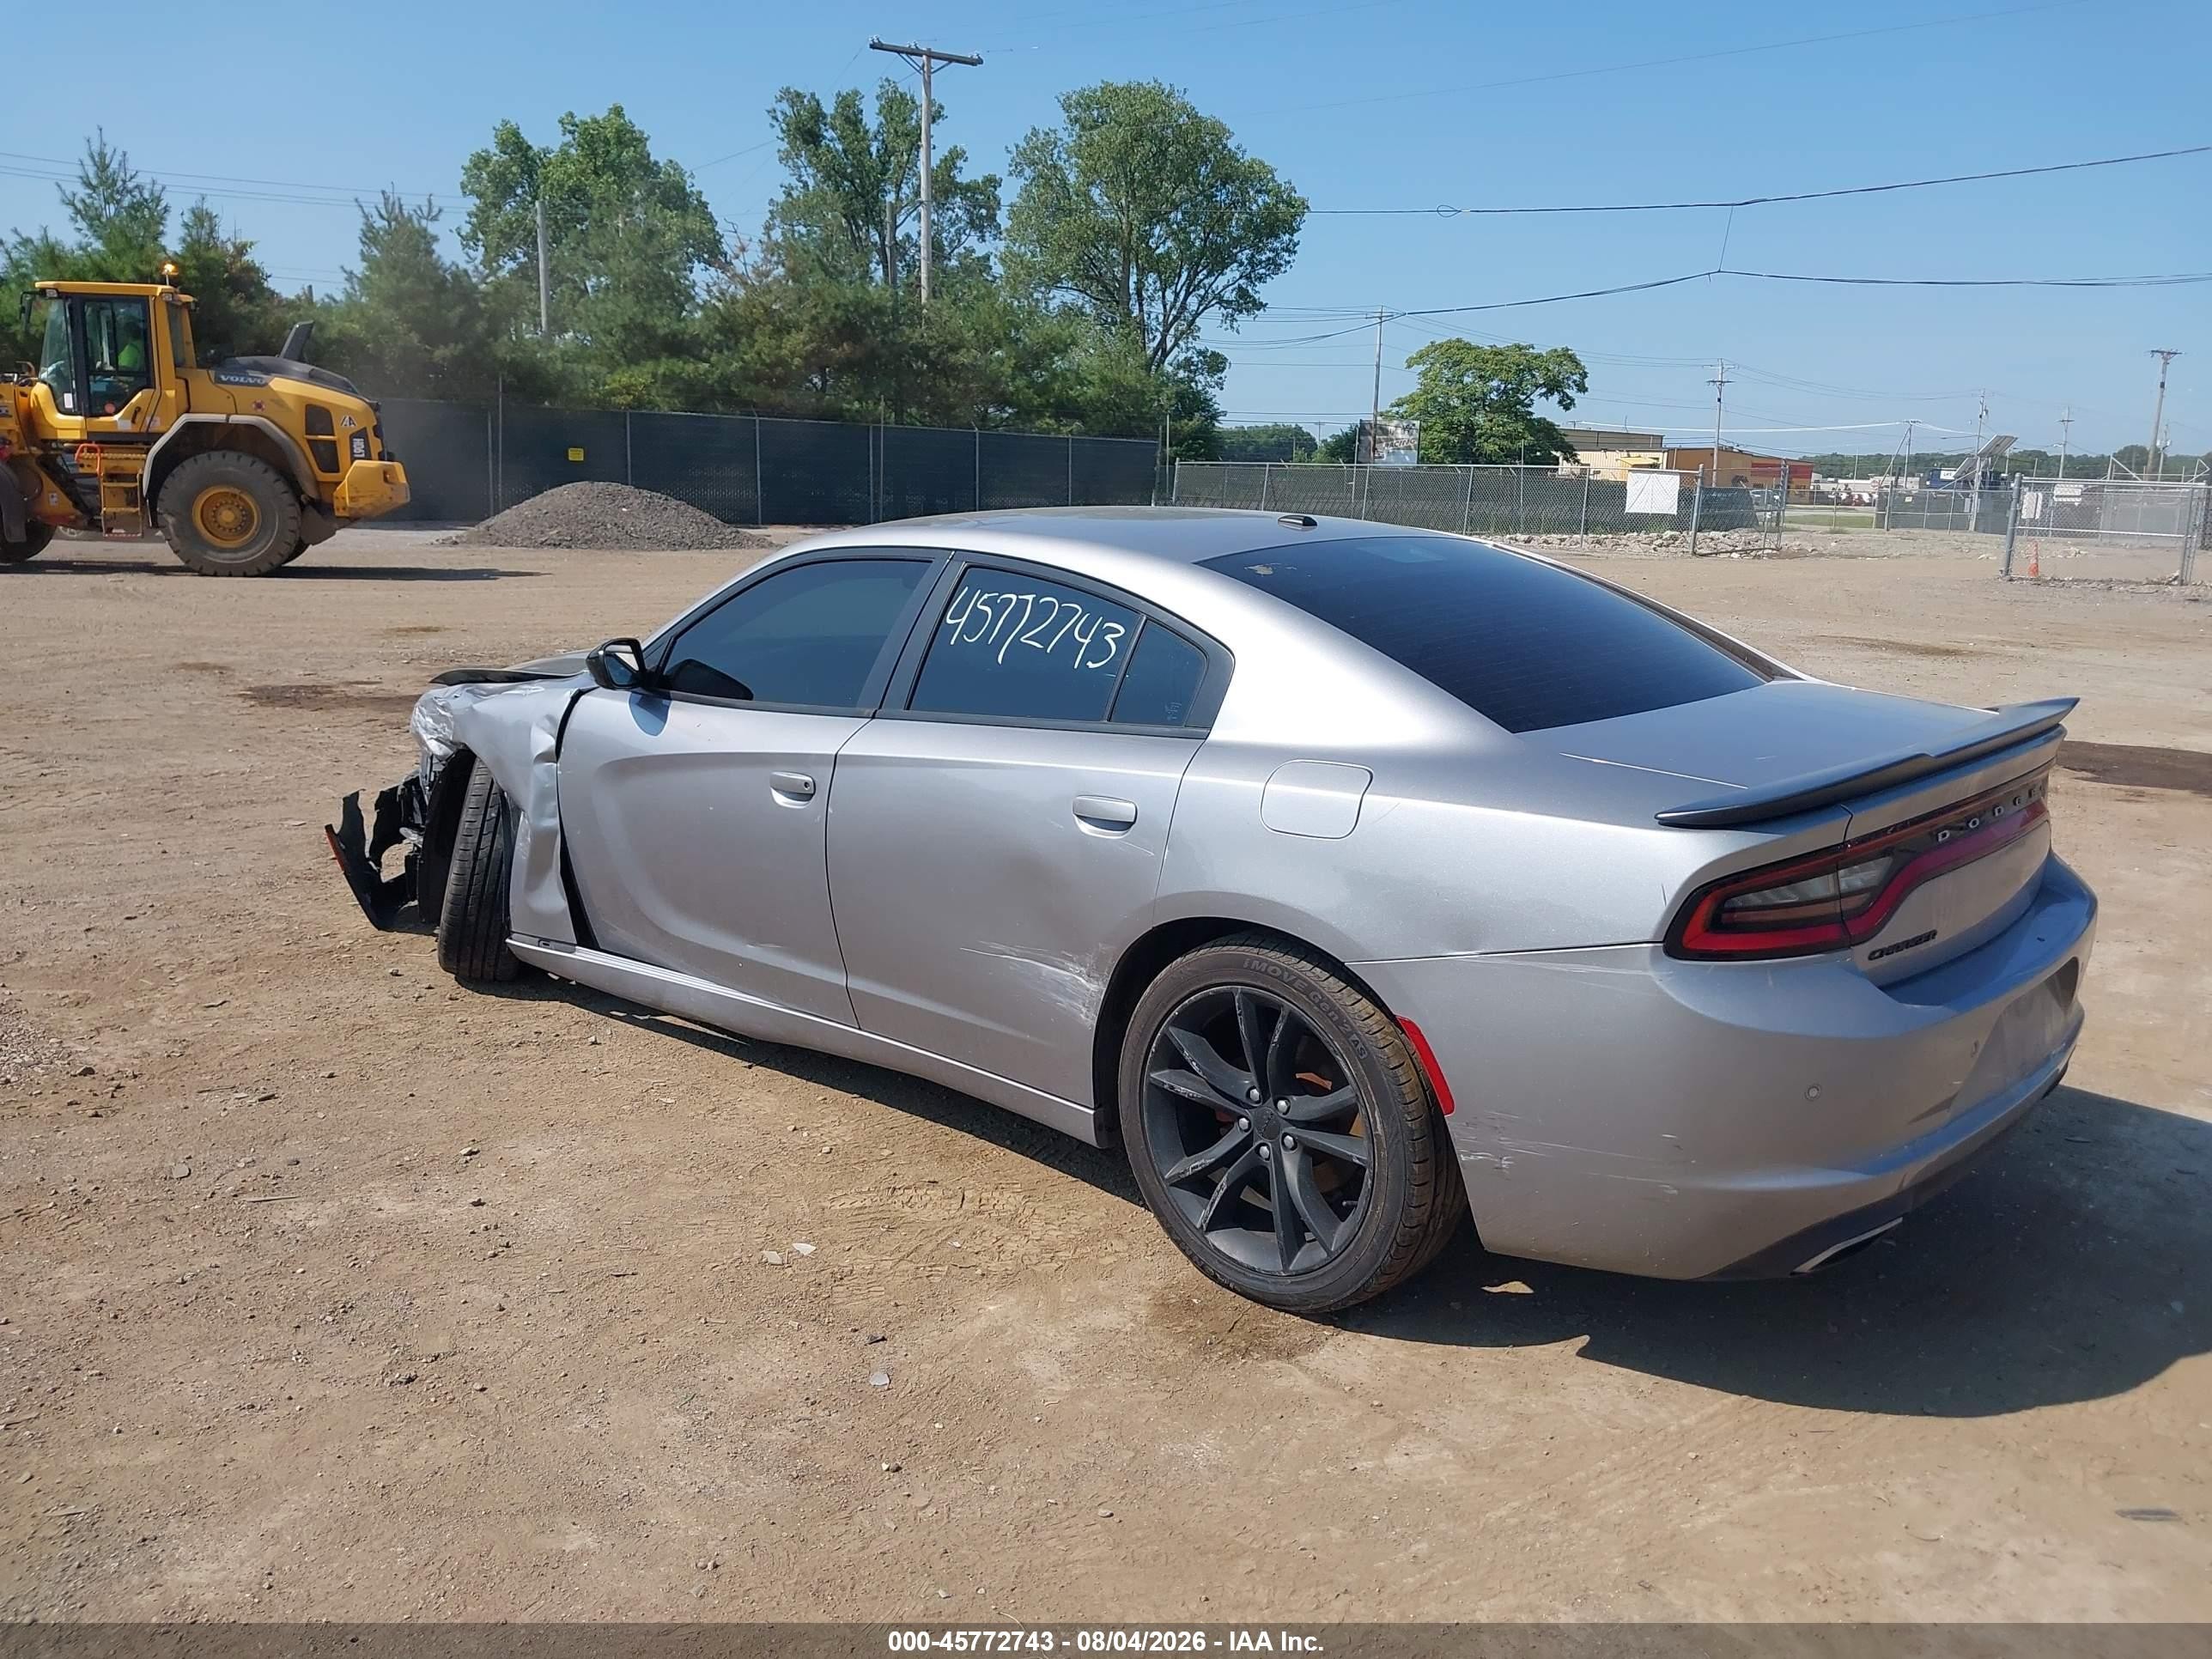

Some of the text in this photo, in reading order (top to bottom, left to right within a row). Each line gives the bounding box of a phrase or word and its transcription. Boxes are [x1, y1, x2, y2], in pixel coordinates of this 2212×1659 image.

[221, 375, 265, 385] VOLVO
[946, 586, 1126, 669] 45772743
[1308, 990, 1340, 1024] Gen
